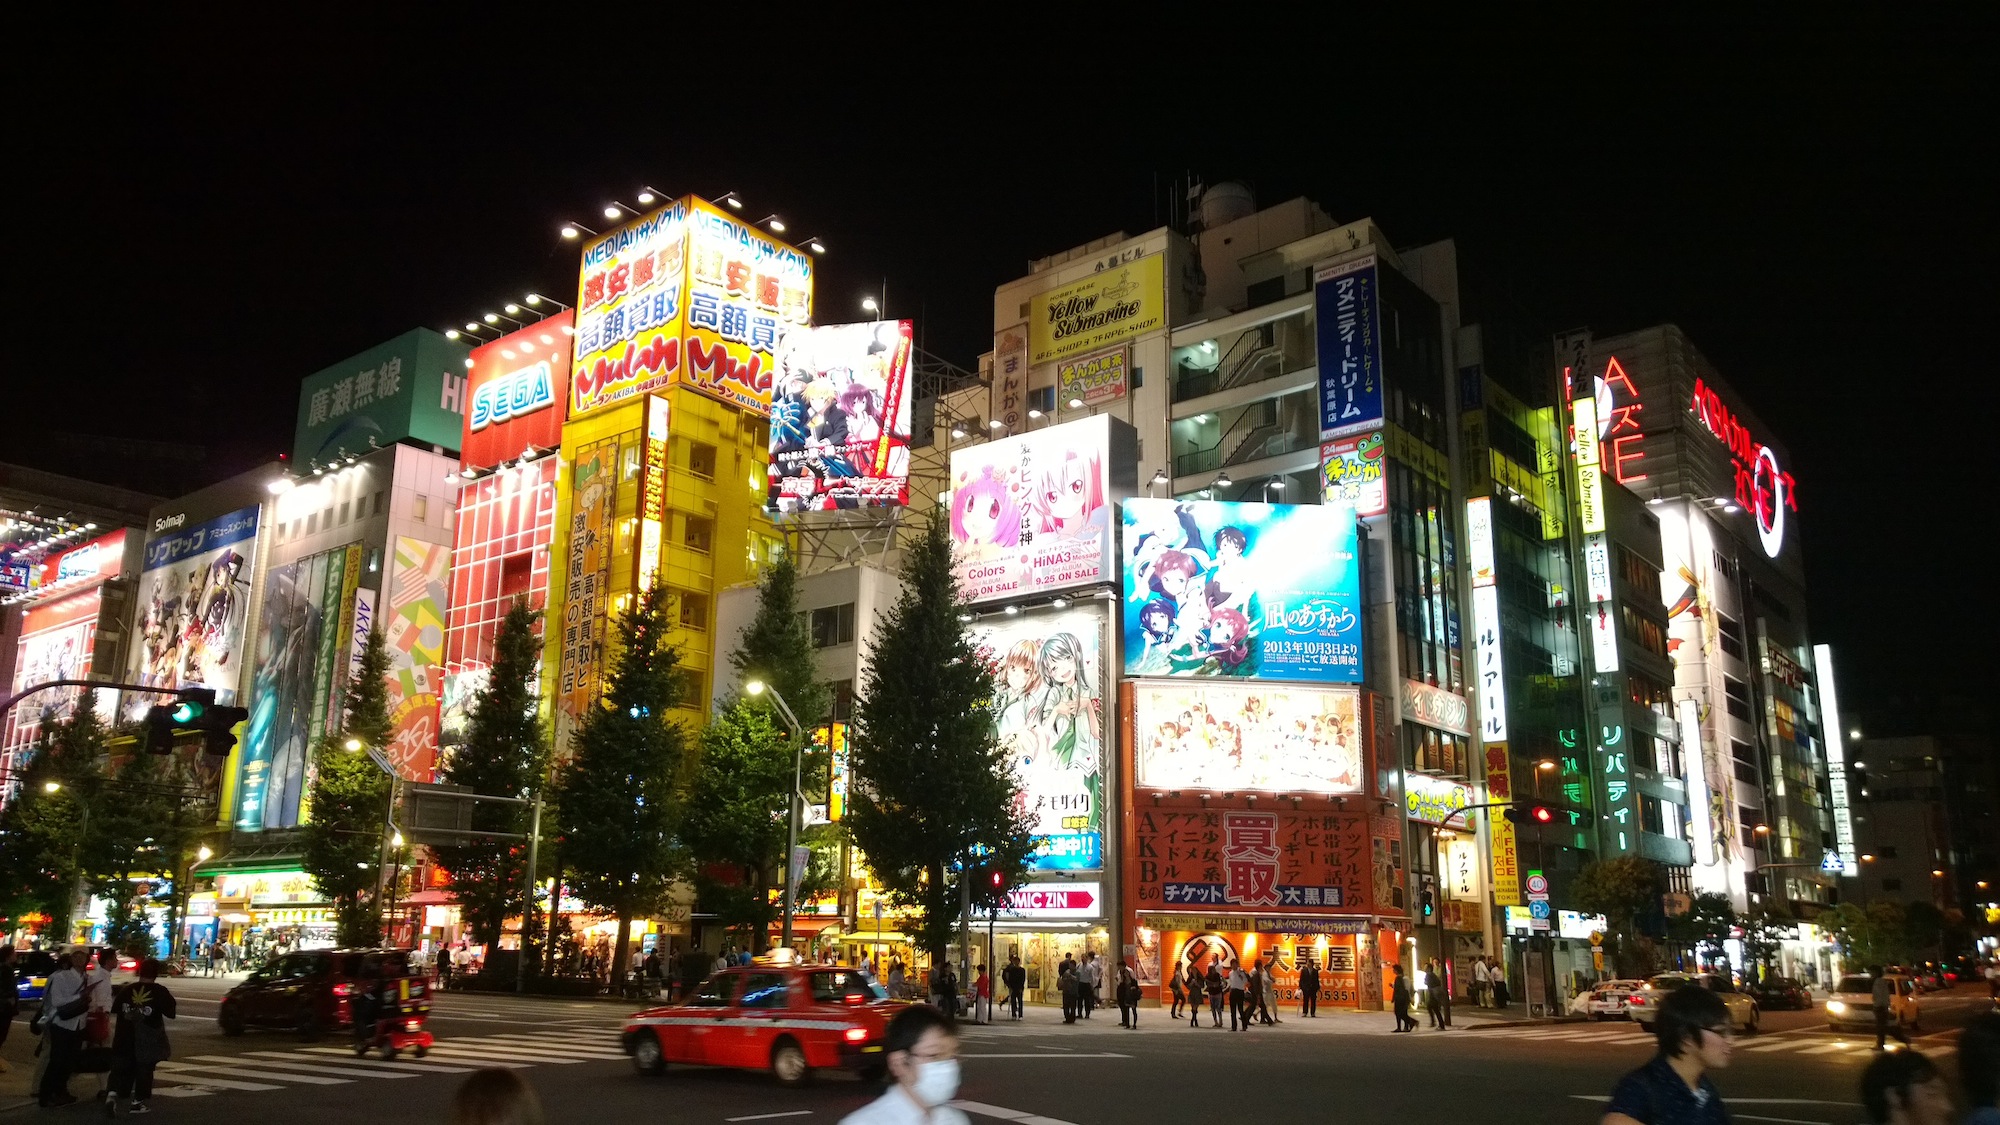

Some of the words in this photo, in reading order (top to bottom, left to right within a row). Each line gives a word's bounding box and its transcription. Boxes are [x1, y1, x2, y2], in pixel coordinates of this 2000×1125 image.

[584, 201, 687, 270] MEDIAリサイクル
[583, 239, 681, 311] 激安販売
[1319, 266, 1346, 279] AMENITY
[1348, 258, 1371, 270] DREAM
[1049, 295, 1098, 322] Yellow
[1050, 289, 1073, 302] HOBBY
[1077, 282, 1095, 293] BASE
[578, 285, 677, 356] 高額買取
[1055, 302, 1140, 338] Submarine
[1336, 277, 1361, 418] アメニティードリーム
[575, 336, 678, 409] Mulan
[307, 356, 401, 427] 廣瀬無線
[473, 363, 551, 428] SEGA
[649, 439, 664, 450] DVD
[1325, 427, 1353, 438] AMENITY
[1357, 421, 1380, 431] DREAM
[1577, 427, 1590, 461] Yellow
[1324, 457, 1381, 482] まんが
[155, 512, 185, 532] Sofmap
[149, 528, 206, 564] ソフマップ
[1033, 552, 1071, 568] HiNA3
[968, 565, 1006, 580] Colors
[981, 586, 993, 595] ON
[996, 581, 1018, 593] SALE
[1035, 575, 1055, 586] 9.25
[1058, 572, 1072, 581] ON
[1075, 567, 1099, 579] SALE
[561, 512, 586, 695] 激安販売の専門店
[1263, 600, 1356, 632] 凪のあすから
[1263, 640, 1358, 656] 2013年10月3日より
[1302, 654, 1358, 665] にて放送開始
[1481, 629, 1503, 735] ルノアール
[1402, 683, 1468, 729] メイドカジノ
[1602, 725, 1629, 850] リバティー
[1163, 812, 1180, 879] アイドル
[1182, 812, 1200, 861] アニメ
[1201, 812, 1220, 882] 美少女系
[1283, 816, 1302, 884] フィギュア
[1303, 816, 1319, 865] ホビー
[1323, 816, 1342, 885] 携帯電話
[1222, 811, 1283, 907] 買取
[1343, 817, 1364, 907] アップルとか
[1459, 852, 1470, 893] ルノアール
[1504, 838, 1516, 876] FREE
[1045, 892, 1068, 908] ZIN
[1164, 884, 1223, 903] チケット
[1284, 886, 1341, 906] 大黒屋
[1531, 879, 1543, 889] 40
[1262, 945, 1354, 974] 大黒屋
